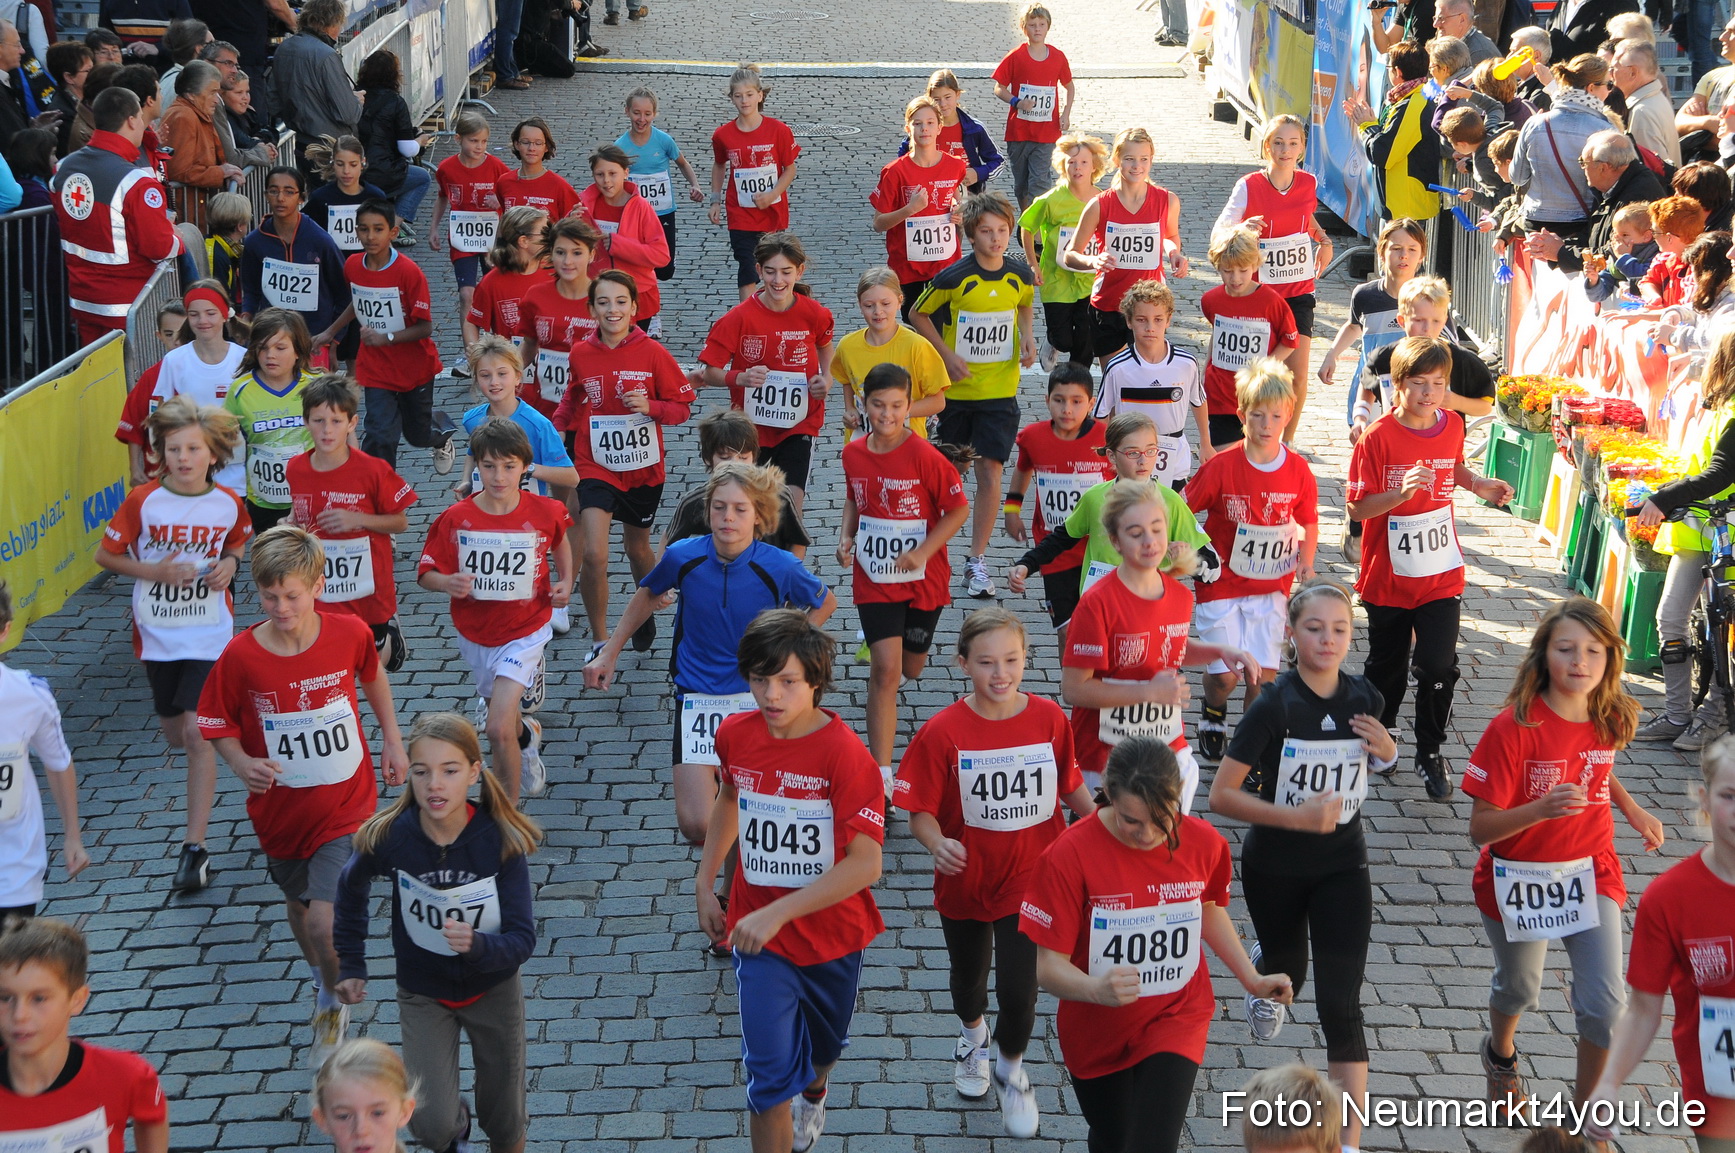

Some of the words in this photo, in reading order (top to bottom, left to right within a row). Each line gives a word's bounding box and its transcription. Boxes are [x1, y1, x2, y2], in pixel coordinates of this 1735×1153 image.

[637, 183, 666, 198] 054
[741, 175, 774, 193] 4084
[334, 217, 358, 234] 40
[455, 222, 493, 238] 4096
[463, 238, 487, 247] Ronja
[912, 226, 951, 246] 4013
[1111, 236, 1154, 254] 4059
[922, 245, 944, 255] Anna
[1119, 254, 1144, 264] Alina
[1265, 246, 1307, 267] 4058
[1269, 267, 1304, 278] Simone
[268, 272, 311, 294] 4022
[280, 293, 297, 304] Lea
[357, 298, 394, 318] 4021
[365, 320, 387, 330] Jona
[963, 324, 1008, 345] 4040
[1217, 331, 1261, 354] 4093
[970, 345, 1001, 357] Moritz
[544, 364, 570, 385] 40
[751, 385, 802, 408] 4016
[253, 408, 289, 419] TEAM
[755, 405, 796, 421] Merima
[599, 426, 651, 452] 4048
[605, 451, 649, 465] Natalija
[1046, 513, 1068, 525] Que
[1398, 518, 1430, 528] PFLEIDERER
[148, 525, 227, 550] MERZ
[467, 537, 502, 546] PFLEIDERER
[1397, 524, 1448, 554] 4108
[1241, 537, 1293, 560] 4104
[465, 550, 527, 576] 4042
[1240, 557, 1291, 575] JULIAN
[149, 578, 210, 602] 4056
[473, 577, 515, 592] Niklas
[151, 602, 206, 618] Valentin
[300, 668, 348, 687] NEUMARKTER
[300, 678, 341, 693] STADTLAUF
[274, 717, 314, 727] PFLEIDERER
[691, 712, 732, 739] 40
[277, 723, 349, 760] 4100
[973, 755, 1015, 766] PFLEIDERER
[775, 770, 783, 778] 11.
[1289, 763, 1361, 792] 4017
[971, 767, 1043, 802] 4041
[748, 799, 786, 813] PFLEIDERER
[981, 803, 1038, 820] Jasmin
[745, 817, 821, 856] 4043
[745, 855, 823, 876] Johannes
[1147, 885, 1158, 893] 11.
[1505, 877, 1585, 911] 4094
[1108, 915, 1155, 926] PFLEIDERER
[1517, 909, 1579, 931] Antonia
[1102, 927, 1189, 964] 4080
